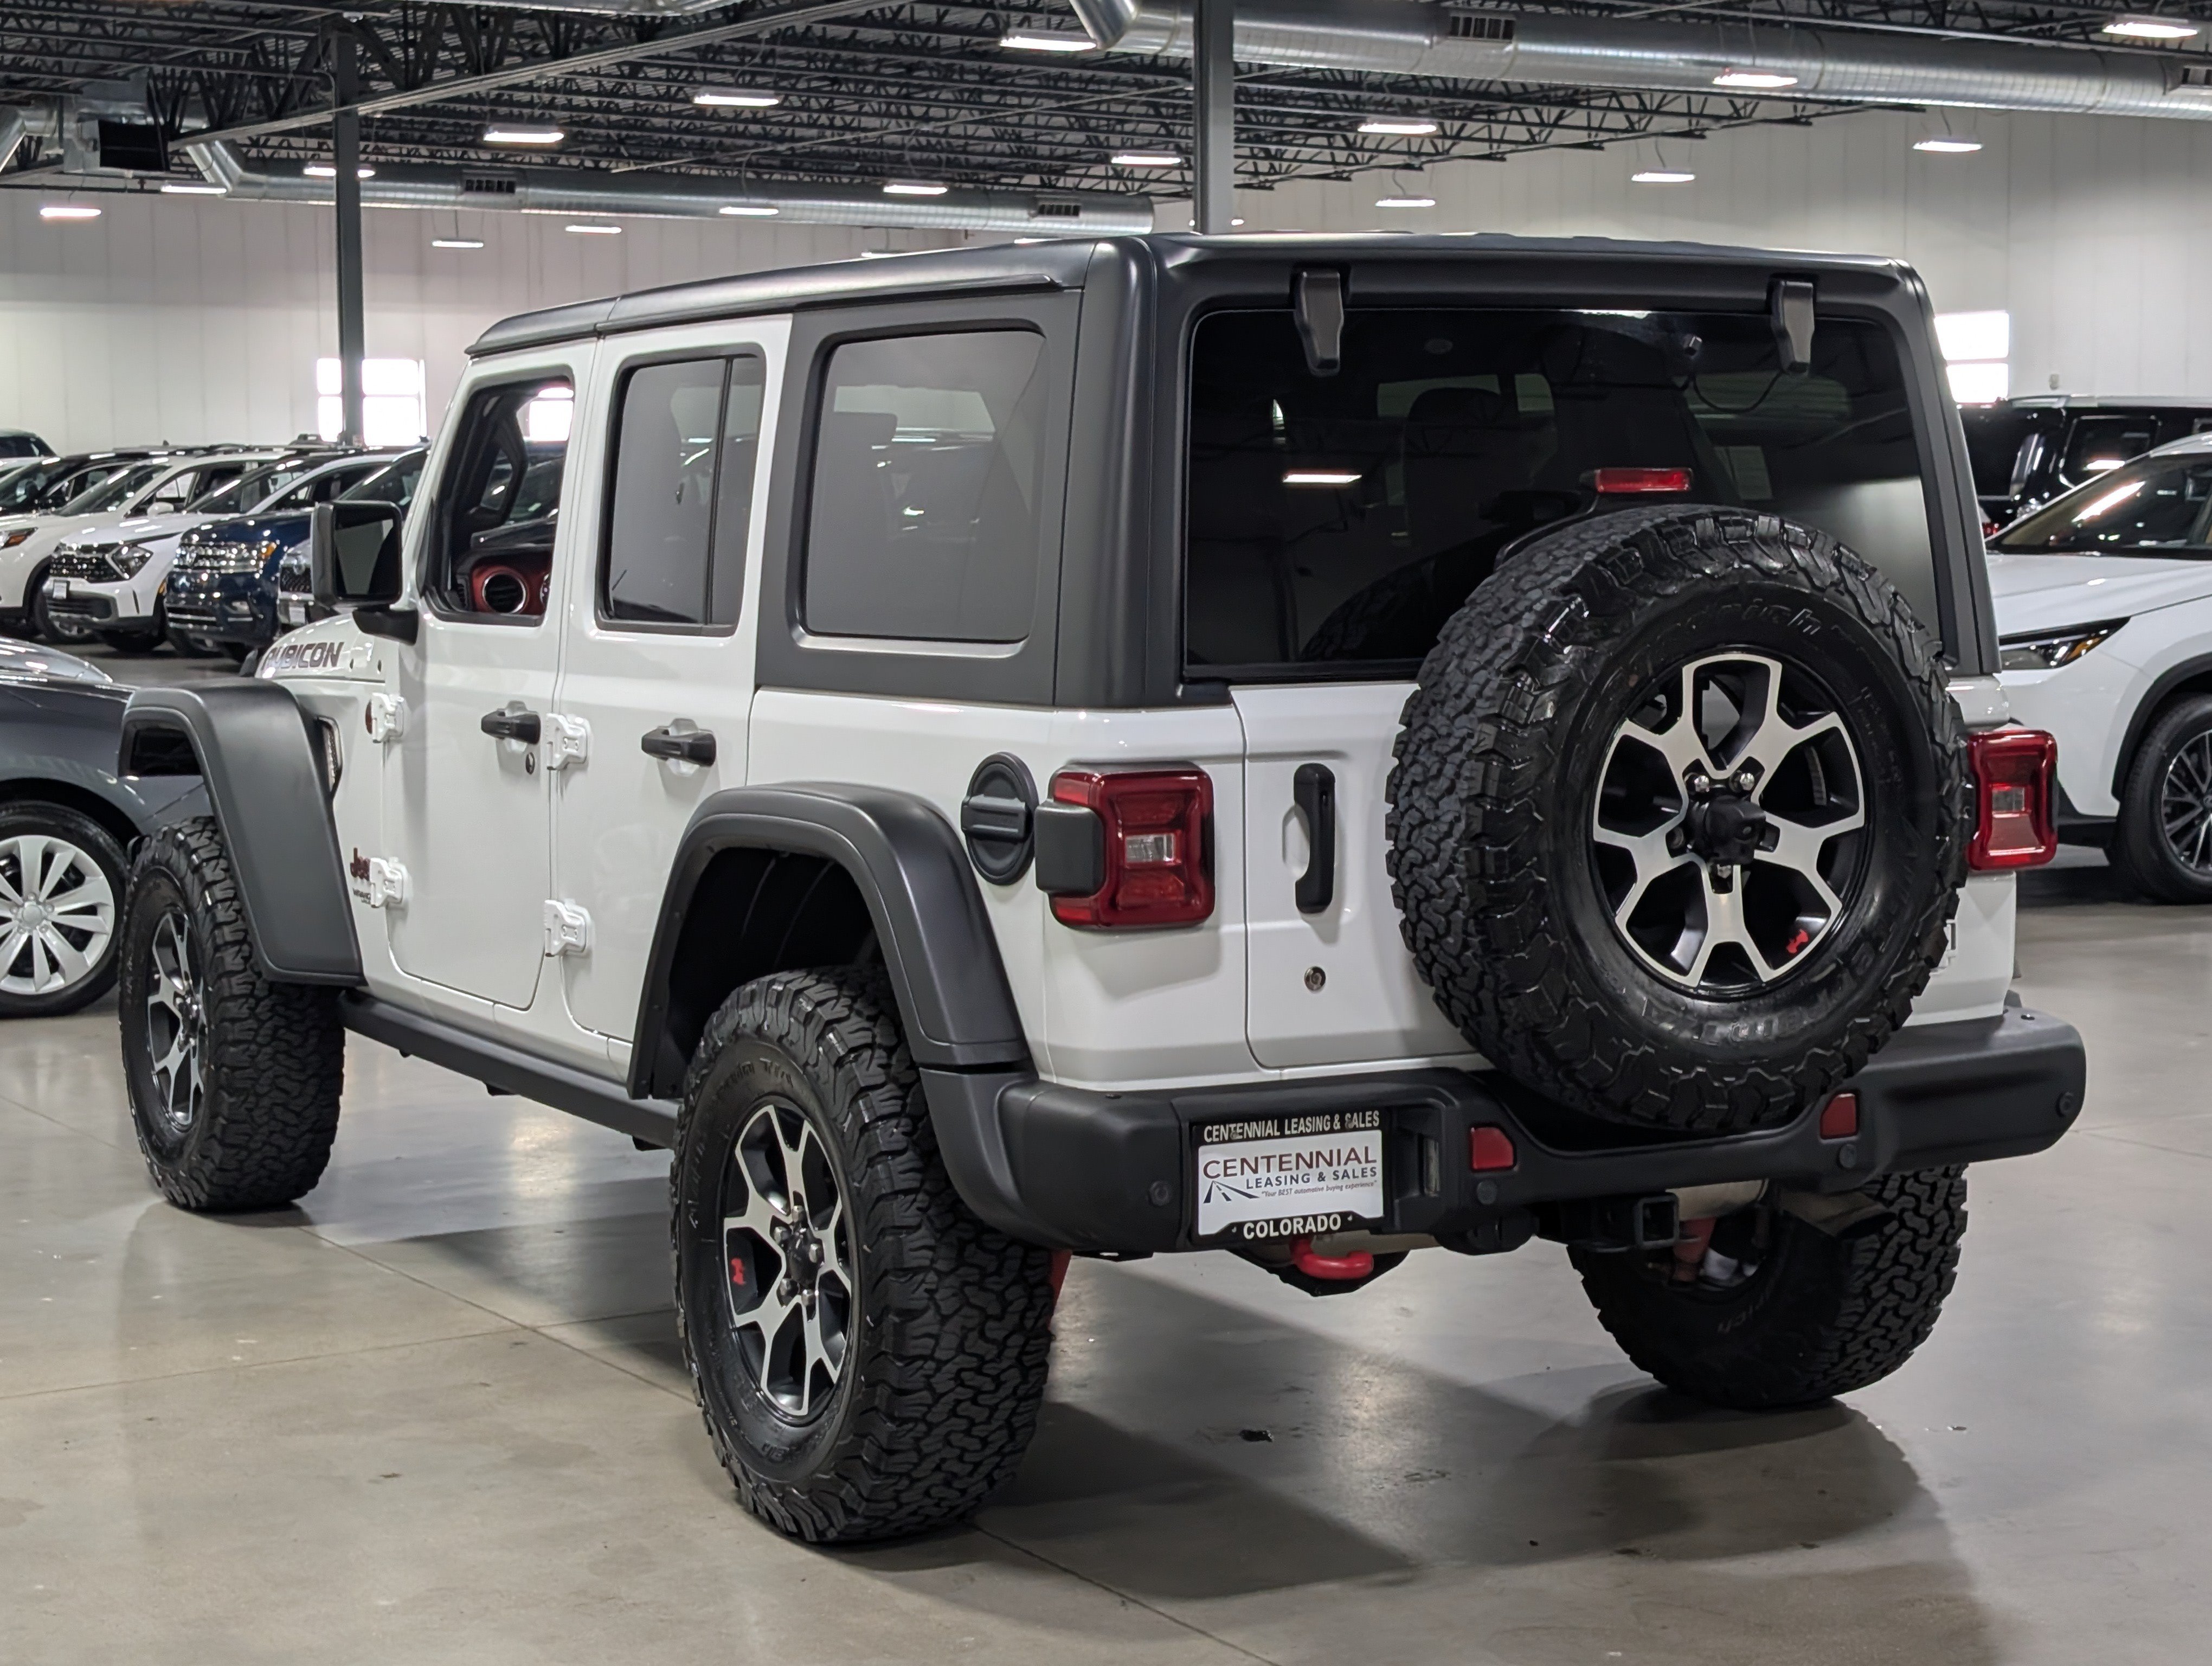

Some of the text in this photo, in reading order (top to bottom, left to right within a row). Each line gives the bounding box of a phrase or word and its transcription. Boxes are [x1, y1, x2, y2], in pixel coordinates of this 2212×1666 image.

[261, 642, 344, 671] RUBICON
[1204, 1110, 1379, 1143] CENTENNIAL LEASING & SALES
[1203, 1146, 1377, 1179] CENTENNIAL
[1246, 1167, 1377, 1189] LEASING & SALES
[1326, 1184, 1343, 1192] buying
[1243, 1214, 1341, 1240] COLORADO
